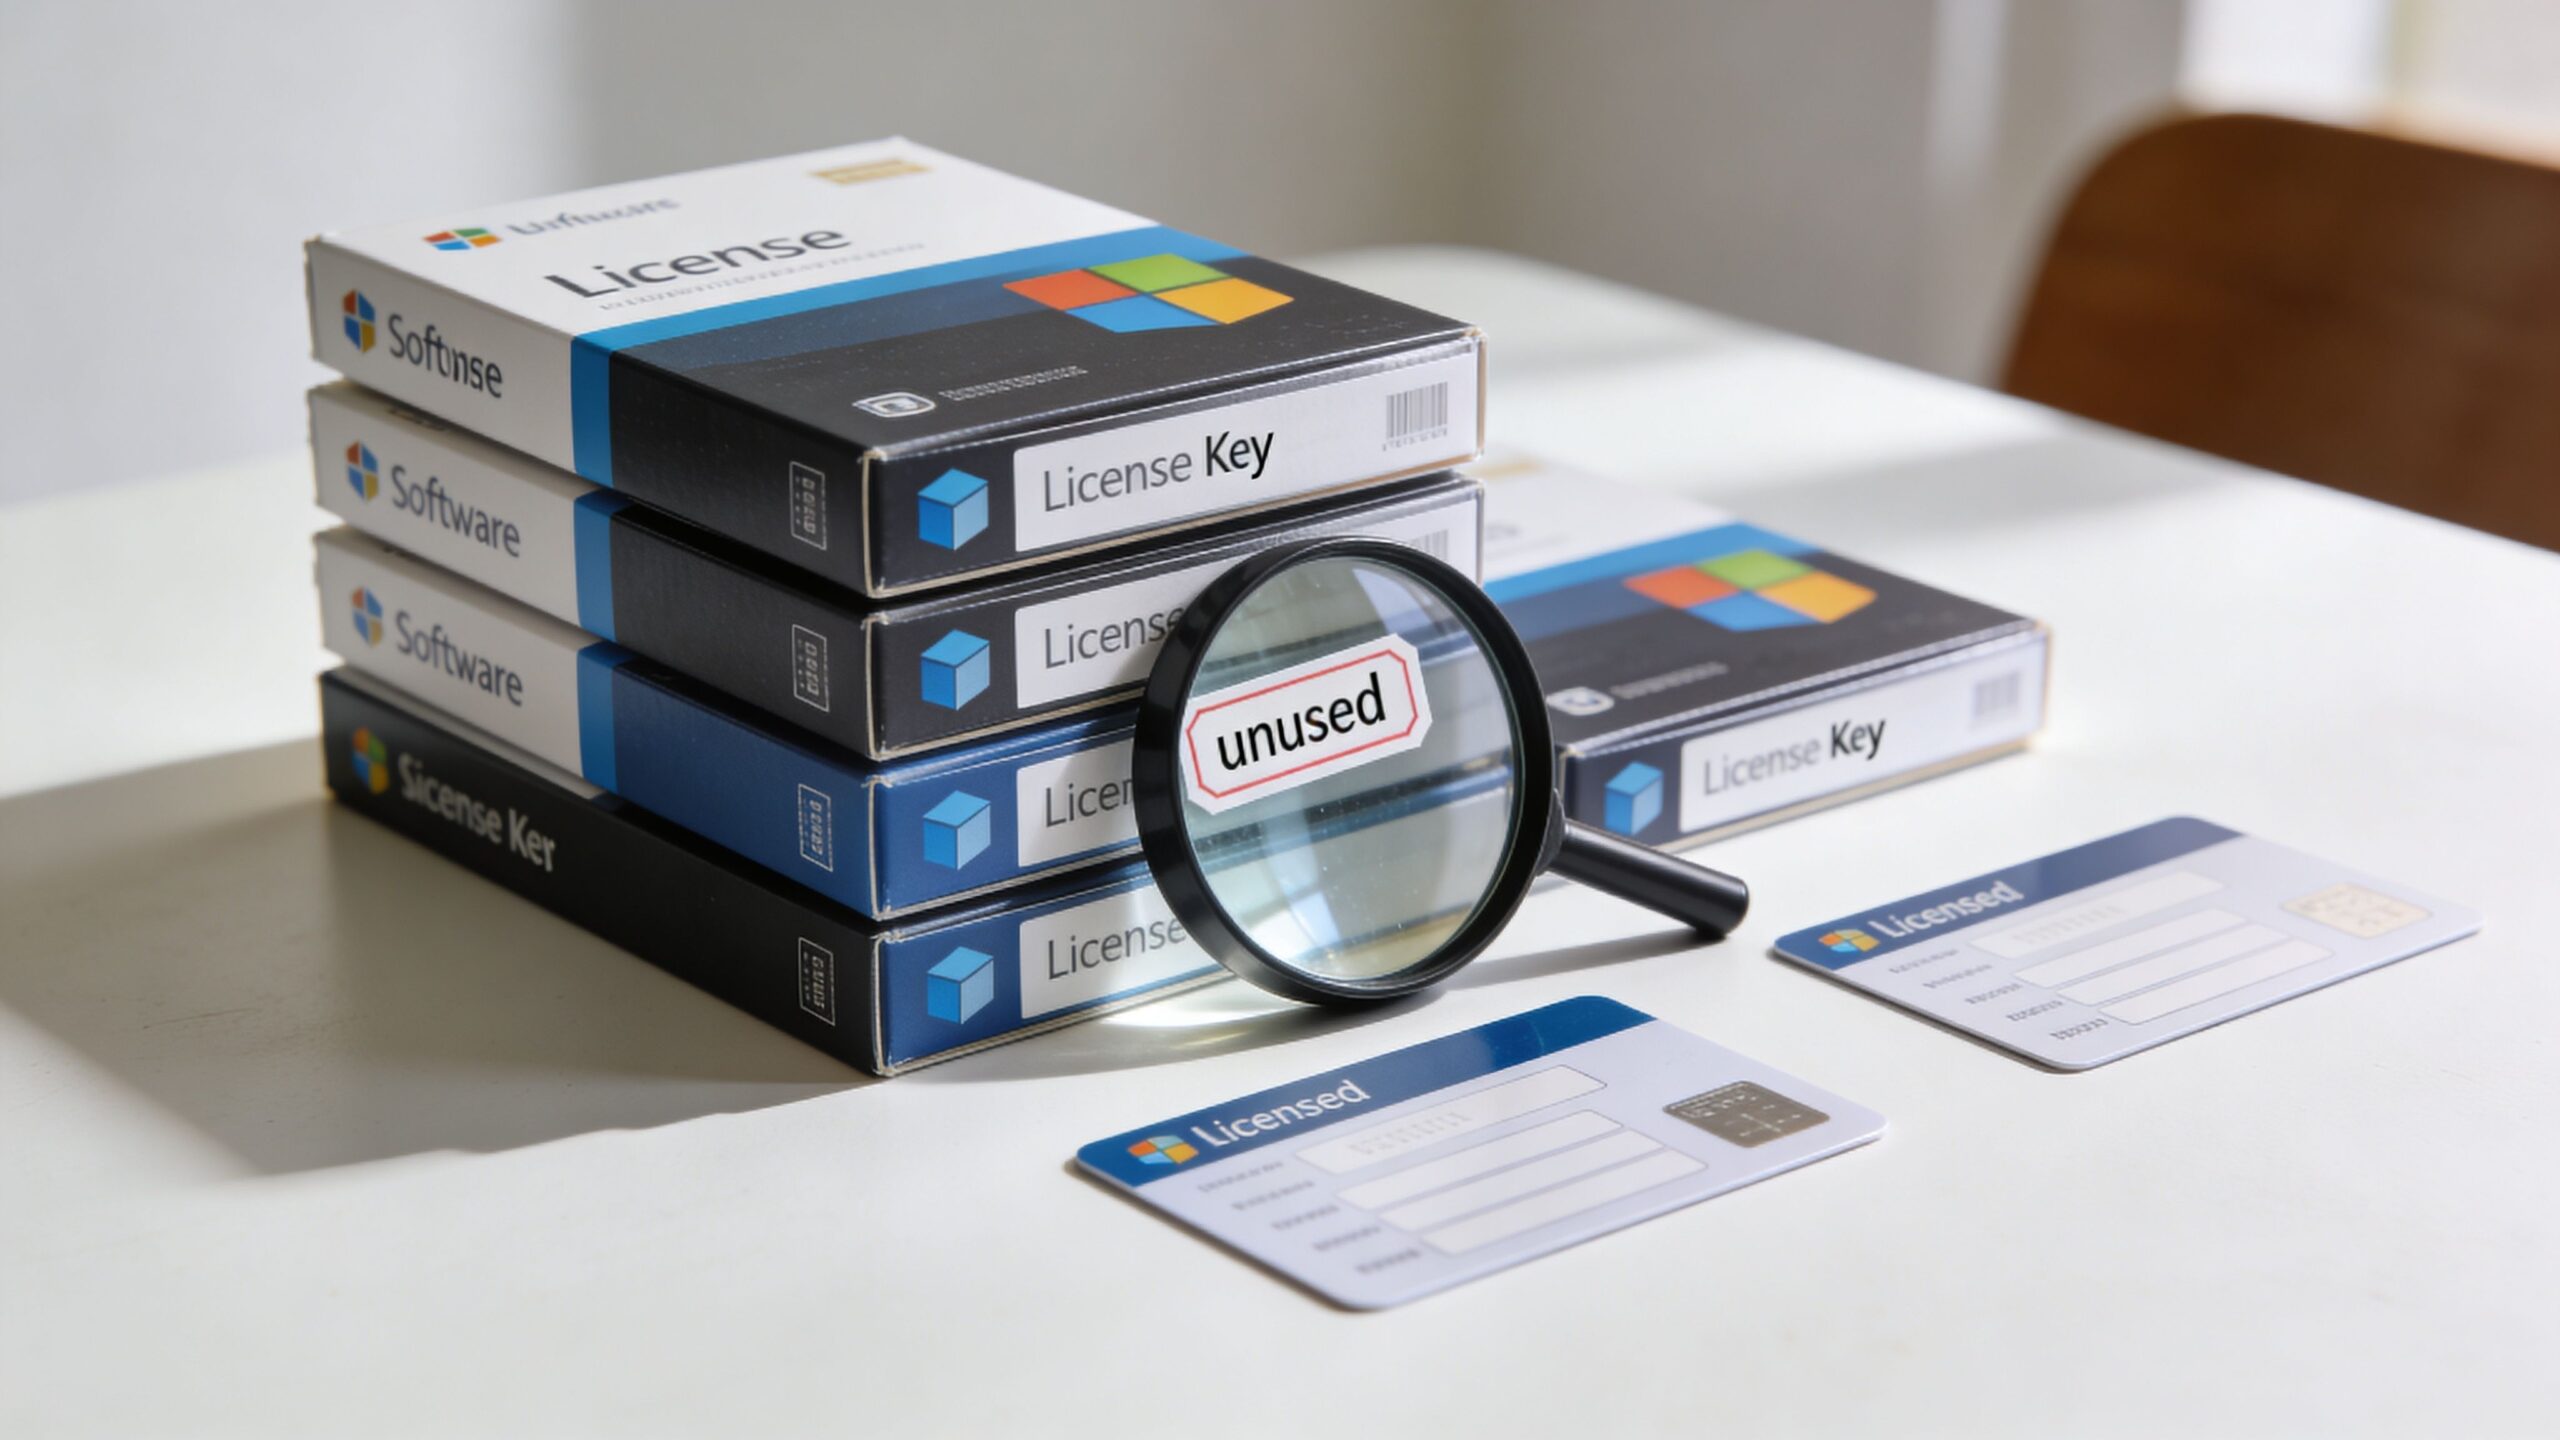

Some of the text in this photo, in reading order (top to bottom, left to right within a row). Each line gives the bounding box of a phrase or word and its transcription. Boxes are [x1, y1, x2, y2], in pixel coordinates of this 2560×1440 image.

[545, 225, 853, 300] License
[1043, 431, 1275, 512] License Key
[391, 465, 521, 558] Software
[396, 610, 523, 707] Software
[1217, 671, 1387, 771] unused
[1703, 718, 1886, 796] License Key
[1048, 917, 1188, 980] License
[1868, 880, 2025, 940] Licensed
[1191, 1079, 1372, 1152] Licensed
